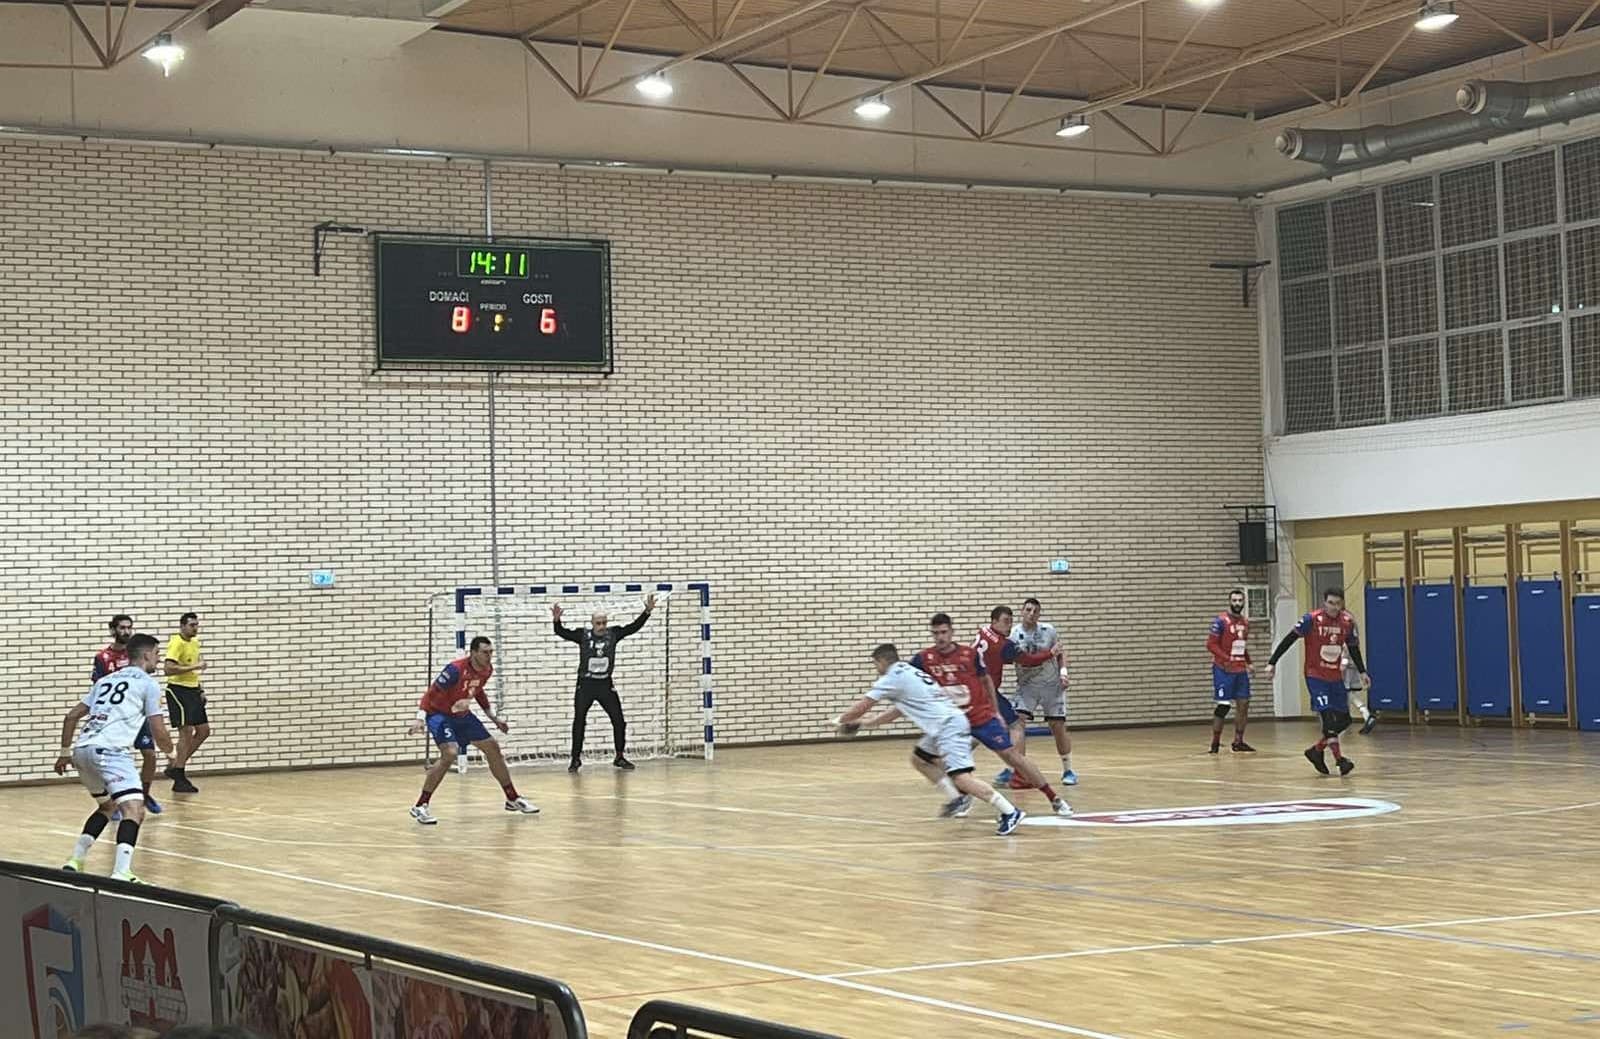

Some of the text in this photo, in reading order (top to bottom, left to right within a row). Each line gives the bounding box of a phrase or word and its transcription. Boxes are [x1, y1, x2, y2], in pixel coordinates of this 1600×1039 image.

[469, 251, 528, 276] 14:11
[428, 288, 470, 303] DOMAĆI
[522, 293, 553, 305] GOSTI
[451, 306, 471, 332] 8
[539, 308, 557, 334] 6
[95, 681, 129, 705] 28
[1218, 686, 1225, 697] 6
[1317, 695, 1329, 707] 17
[444, 727, 453, 739] 5
